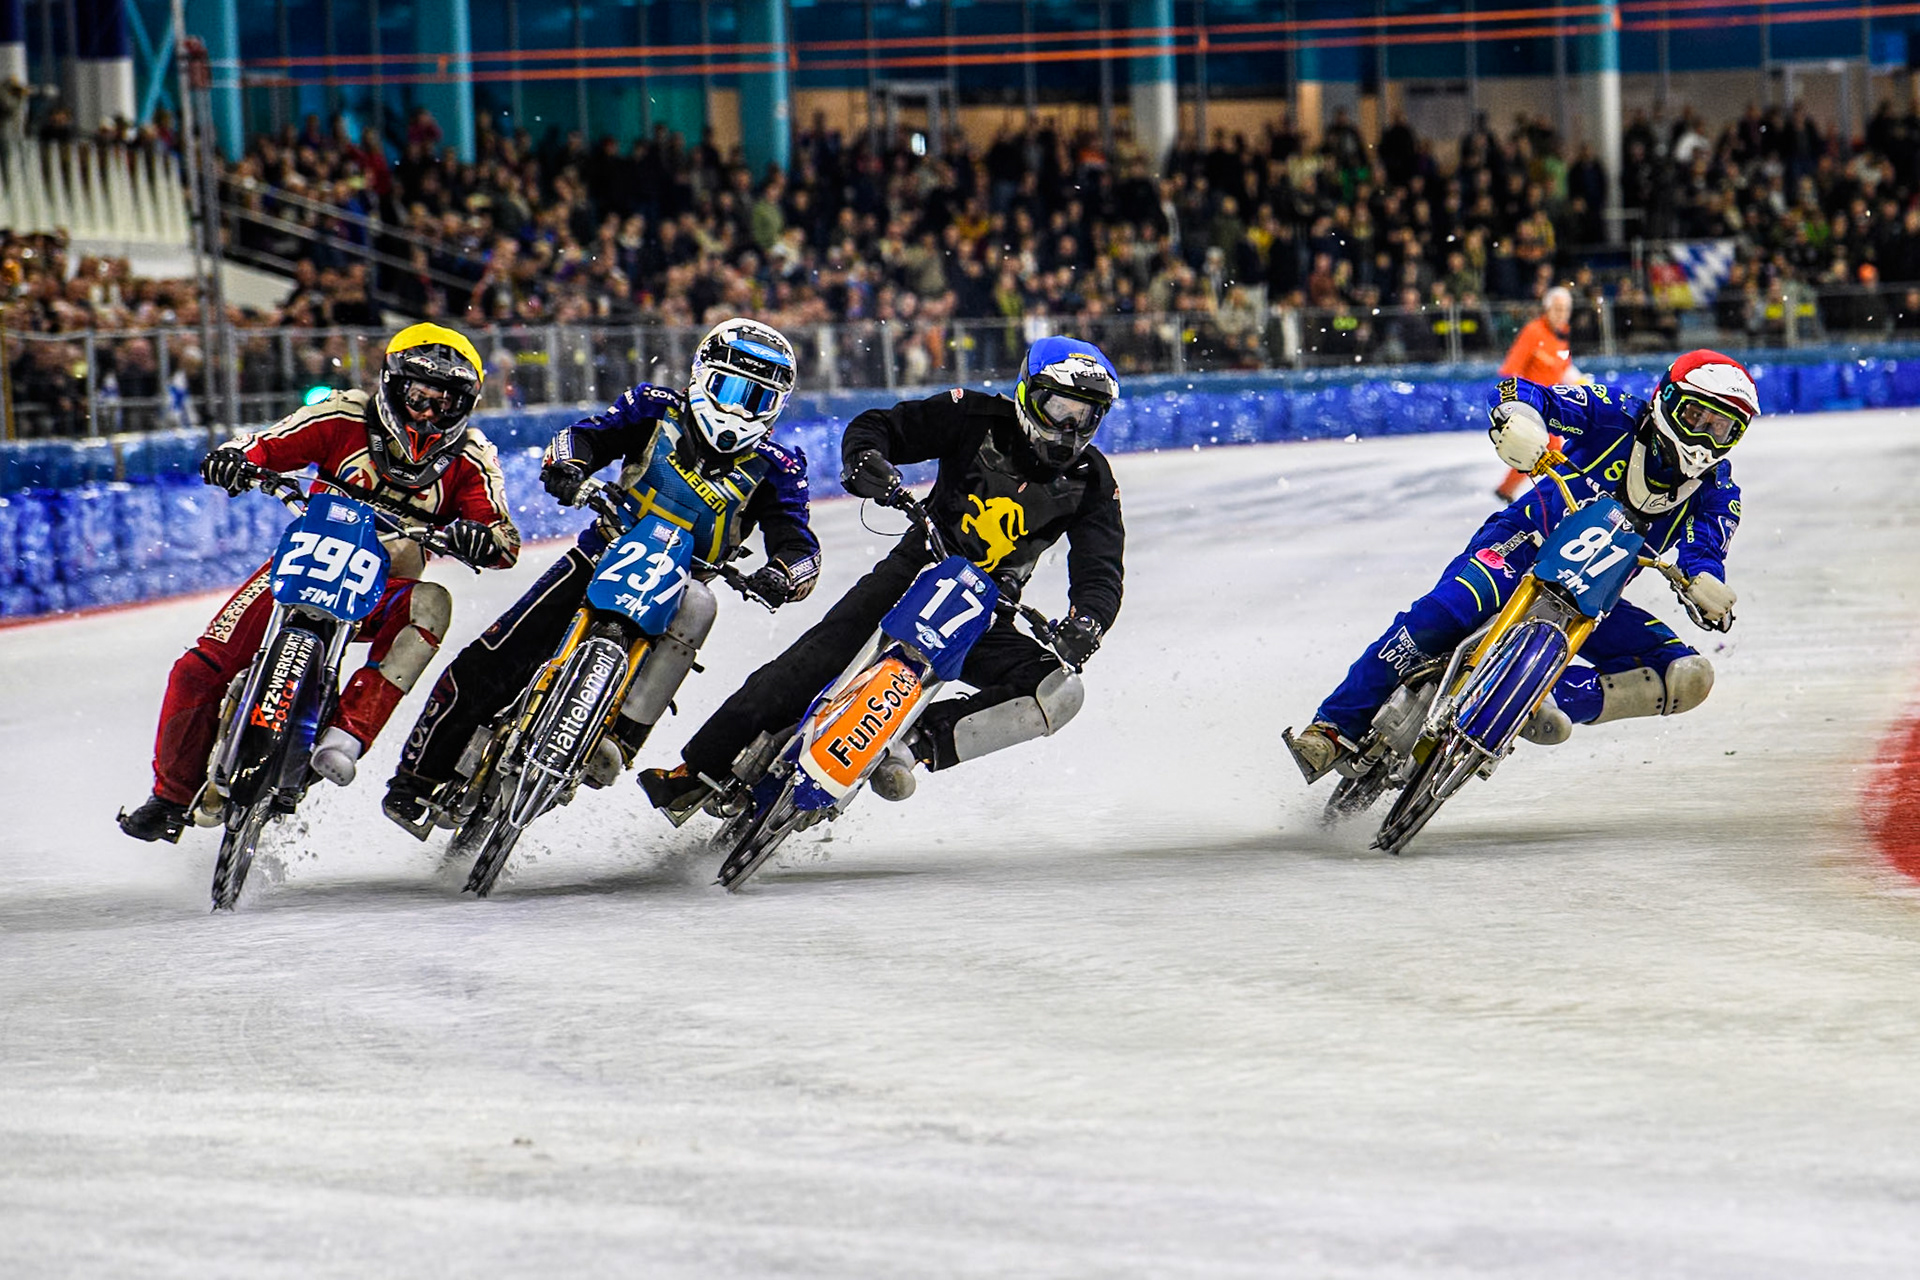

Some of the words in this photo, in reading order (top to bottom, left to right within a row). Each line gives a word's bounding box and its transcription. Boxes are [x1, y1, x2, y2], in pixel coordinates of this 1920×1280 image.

[276, 531, 382, 596] 299
[597, 541, 688, 605] 237
[1559, 526, 1629, 578] 81
[299, 586, 338, 607] FIM
[615, 593, 651, 619] FIM
[1556, 568, 1590, 595] FIM
[919, 577, 985, 639] 17
